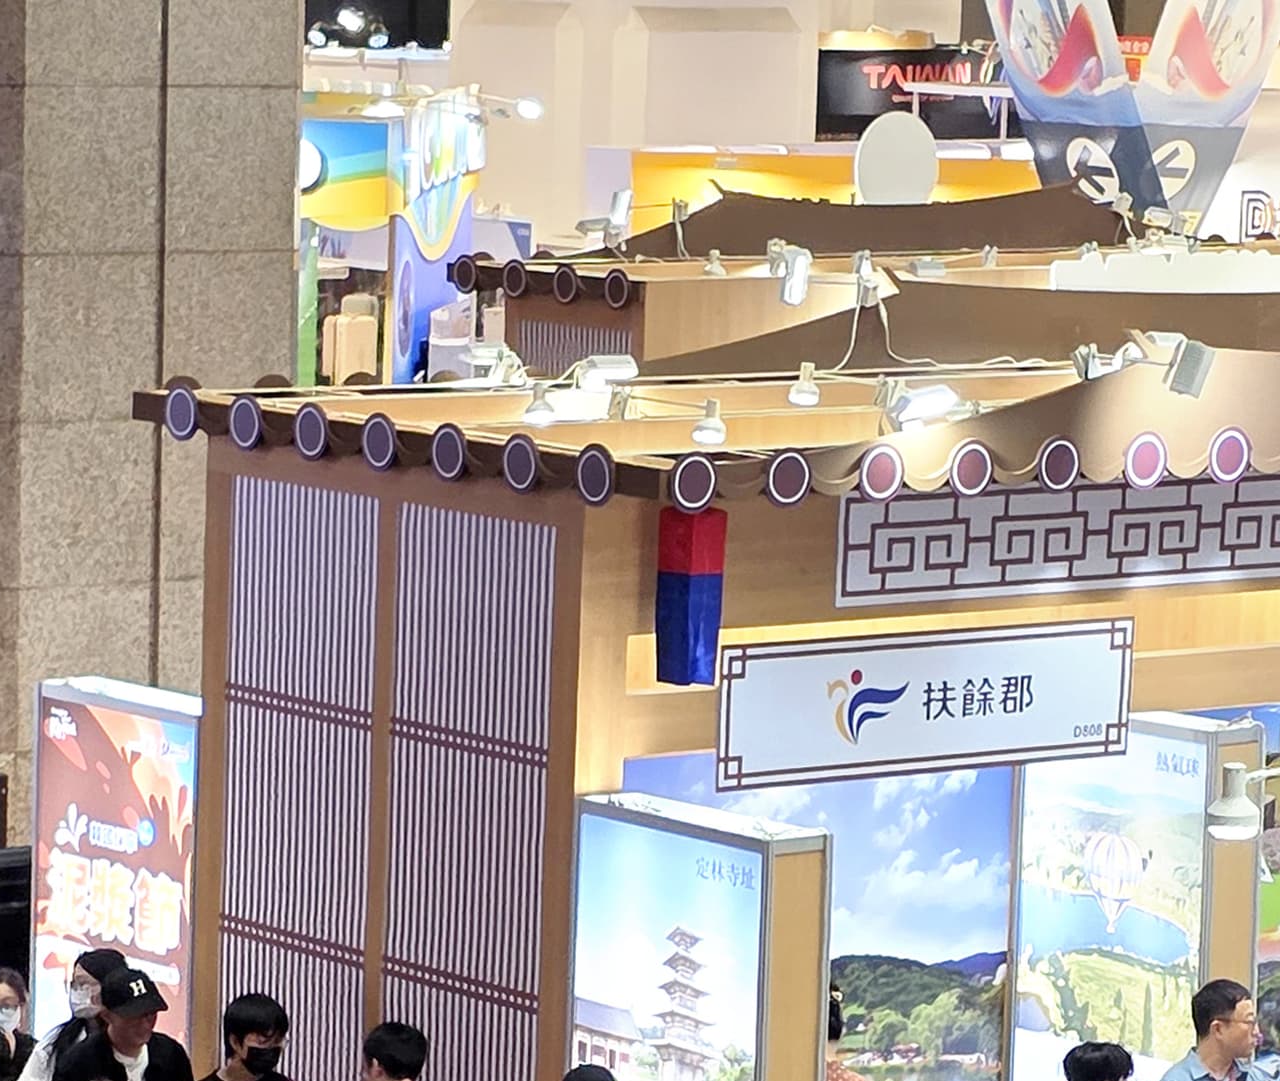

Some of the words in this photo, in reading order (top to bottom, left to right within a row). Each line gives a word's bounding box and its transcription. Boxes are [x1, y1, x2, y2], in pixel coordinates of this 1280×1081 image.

[862, 62, 971, 89] TAIWAN
[922, 673, 1034, 721] 扶餘郡
[130, 979, 147, 997] H
